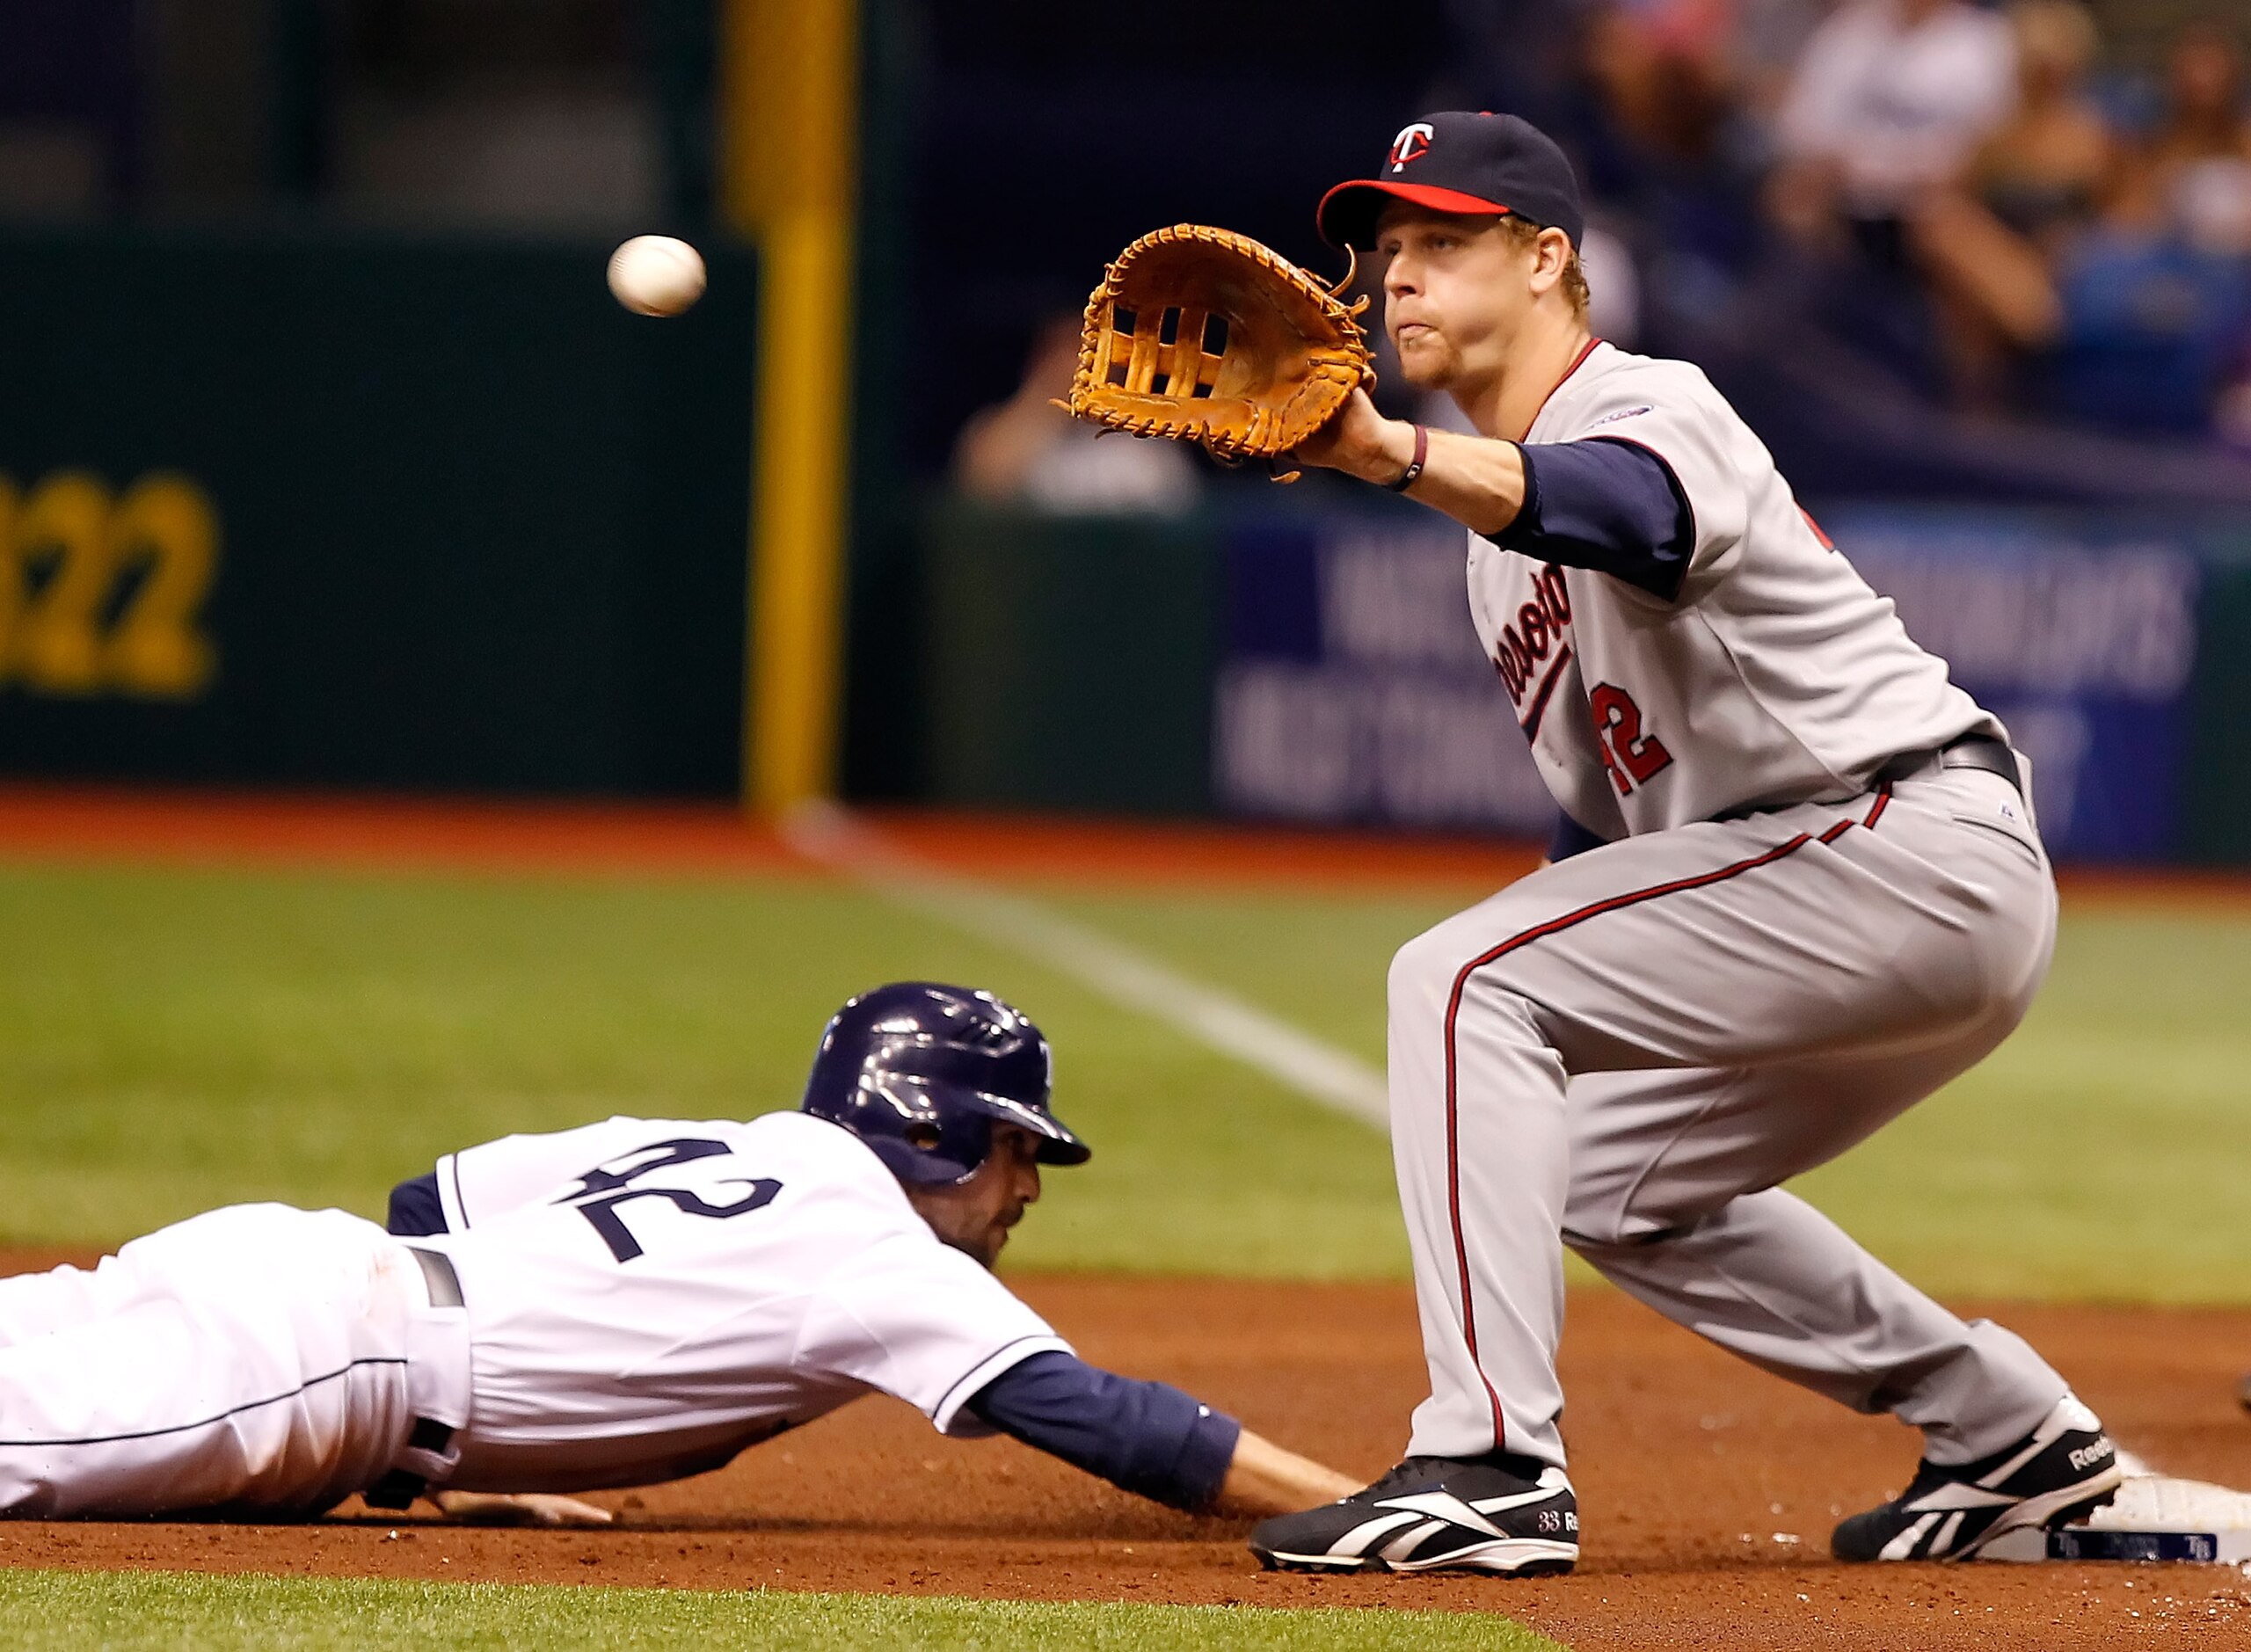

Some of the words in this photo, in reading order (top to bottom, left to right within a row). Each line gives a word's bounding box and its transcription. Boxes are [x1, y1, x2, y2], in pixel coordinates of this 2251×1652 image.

[0, 473, 220, 695] 22
[548, 1139, 784, 1263] 42
[1539, 1510, 1560, 1532] 33
